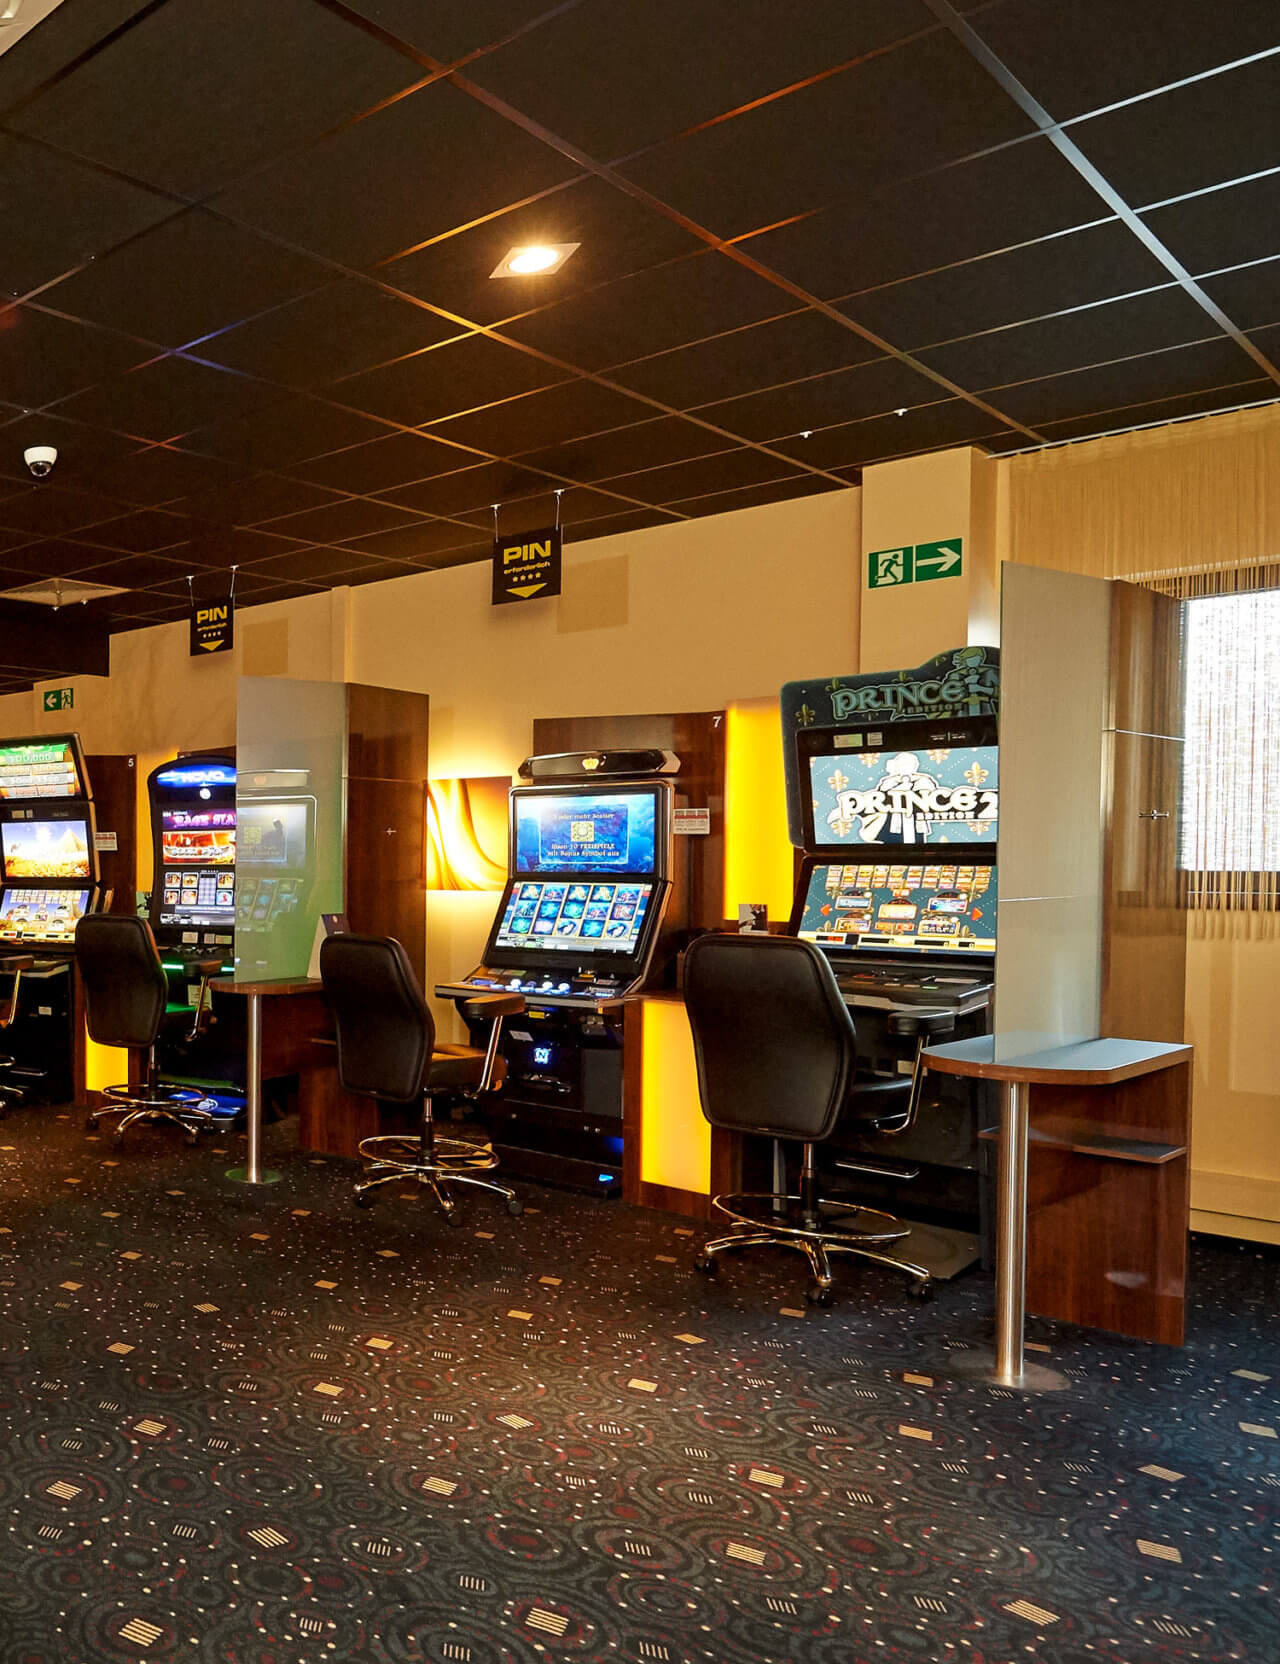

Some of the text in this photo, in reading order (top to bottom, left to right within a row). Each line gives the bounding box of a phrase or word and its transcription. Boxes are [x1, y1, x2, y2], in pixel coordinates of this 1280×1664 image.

[503, 539, 552, 565] PIN
[196, 605, 228, 625] PIN
[832, 679, 967, 718] PRINCE
[907, 703, 963, 714] EDITION
[712, 715, 722, 728] 7
[127, 757, 134, 768] 5
[839, 786, 977, 821] PRINCE
[915, 812, 975, 820] EDITION
